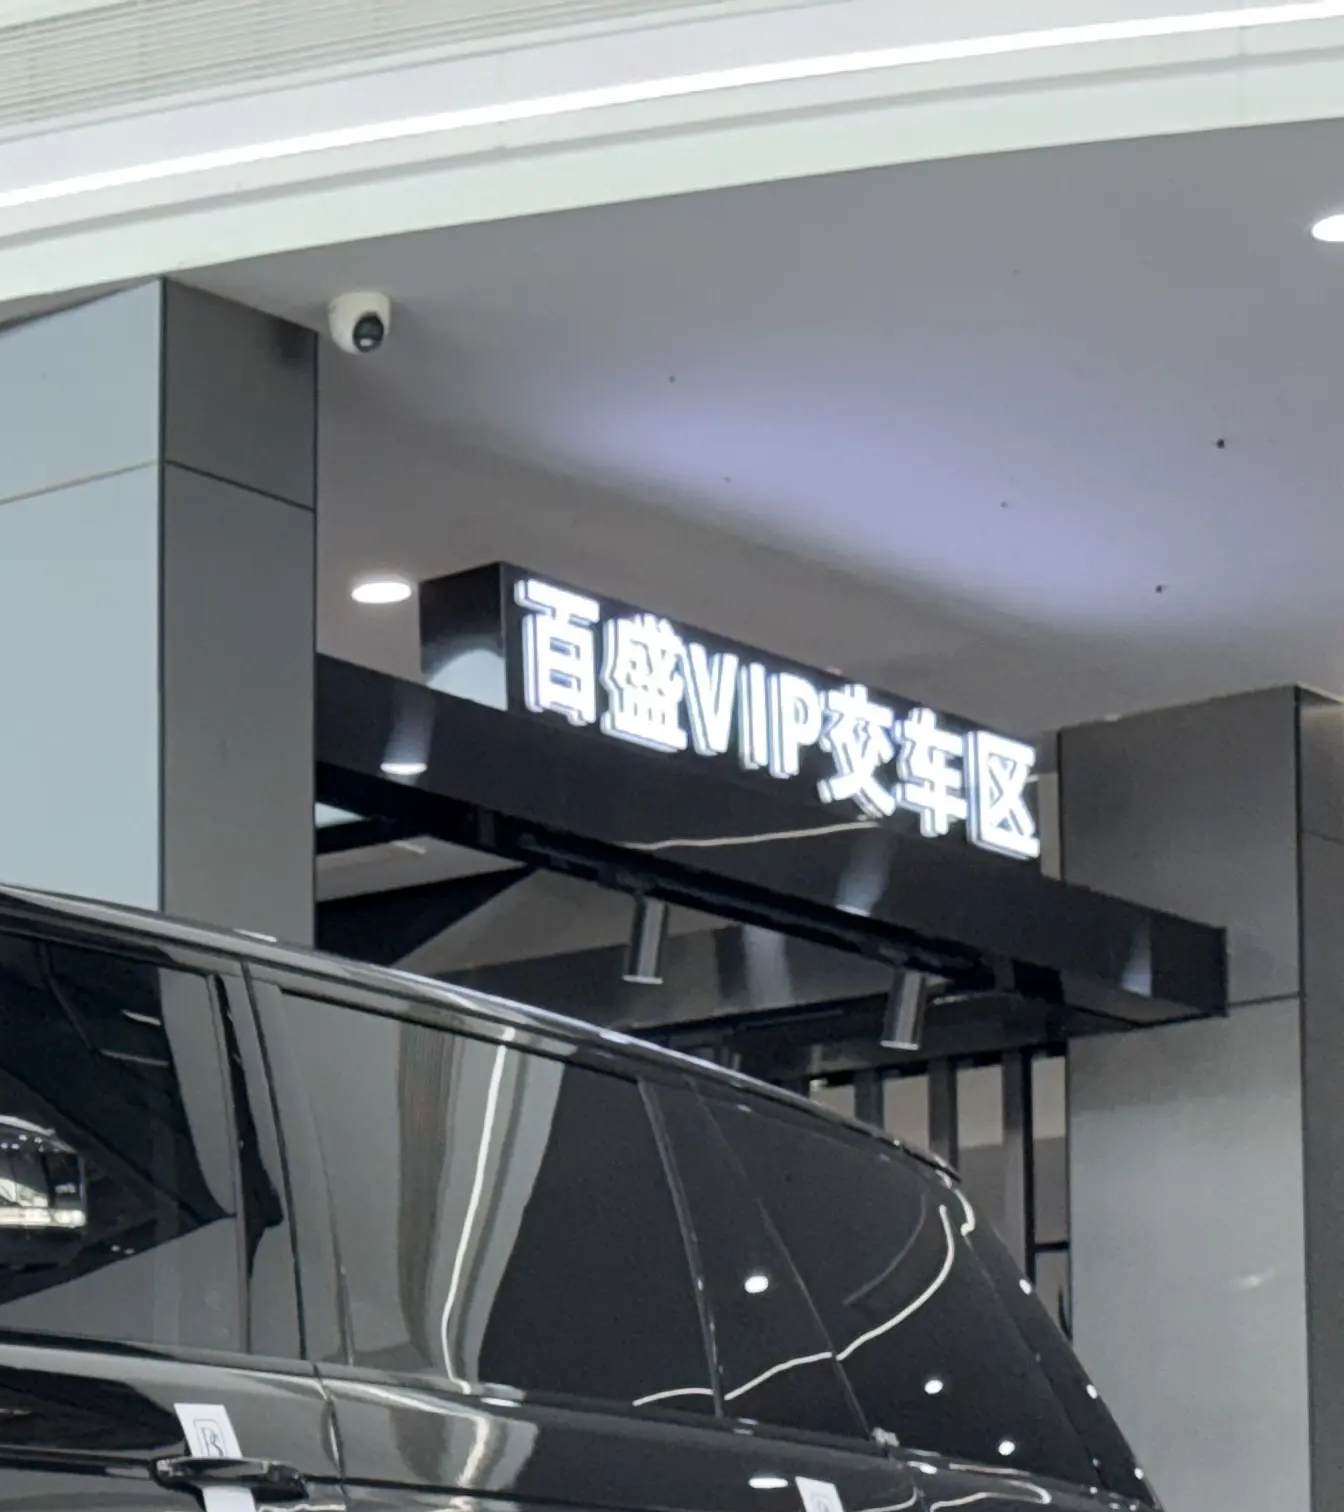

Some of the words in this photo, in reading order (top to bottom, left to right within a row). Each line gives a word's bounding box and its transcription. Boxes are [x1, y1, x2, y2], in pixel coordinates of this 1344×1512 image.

[515, 578, 1041, 860] 百盛VIP交车区
